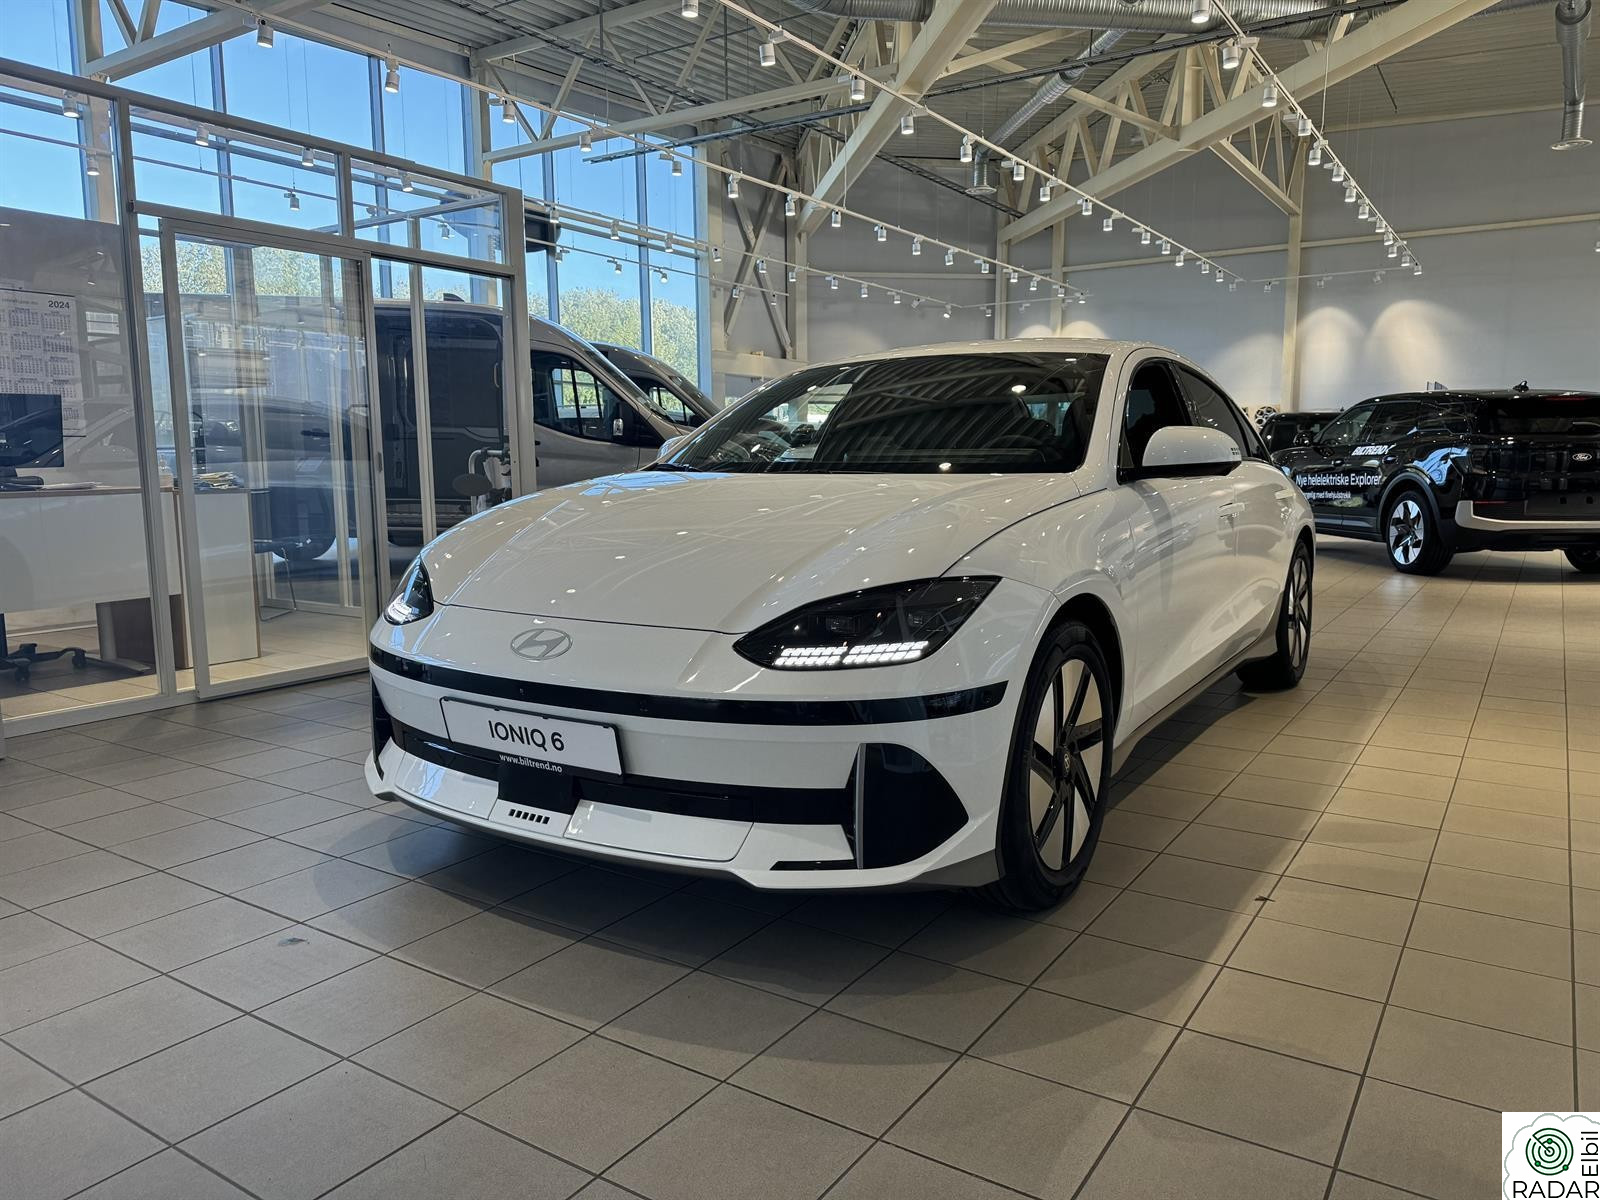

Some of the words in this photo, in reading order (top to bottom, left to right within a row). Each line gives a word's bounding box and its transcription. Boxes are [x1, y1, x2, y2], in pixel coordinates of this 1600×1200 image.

[47, 300, 70, 309] 2024
[1307, 473, 1350, 486] helelektriske
[1350, 473, 1381, 487] Explorer
[488, 720, 548, 752] IONIQ
[551, 732, 565, 752] 6
[499, 754, 563, 773] www.biltrend.no
